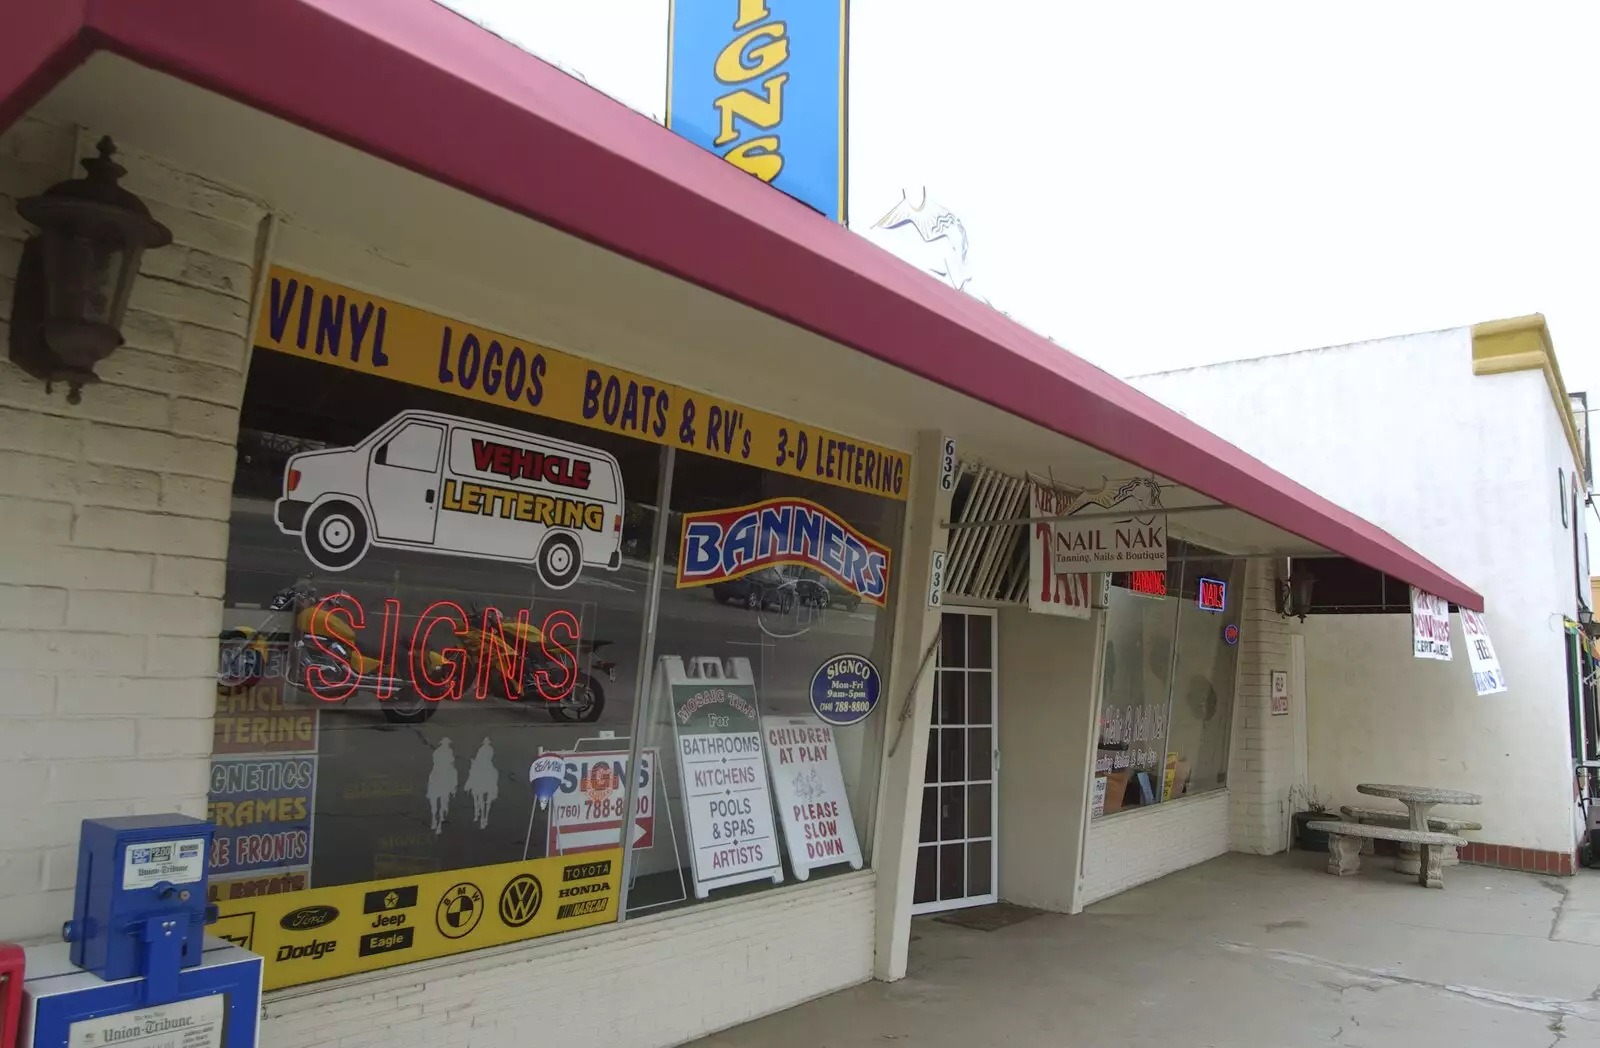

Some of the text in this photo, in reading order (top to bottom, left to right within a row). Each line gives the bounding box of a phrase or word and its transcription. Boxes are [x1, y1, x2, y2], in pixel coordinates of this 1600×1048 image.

[270, 278, 904, 494] VINYL LOGOS BOATS & RV's 3-D LETTERING
[471, 438, 591, 489] VEHICLE
[942, 439, 955, 490] 636
[442, 479, 604, 532] LETTERING
[1056, 527, 1163, 552] NAIL NAK
[684, 505, 886, 598] BANNERS
[1056, 550, 1165, 563] Tanning, Nails & Boutique
[931, 554, 943, 605] 636
[1202, 582, 1224, 608] NAILS
[305, 593, 581, 701] SIGNS
[827, 660, 871, 680] SIGNCO
[827, 690, 866, 699] 9am-5pm
[831, 680, 864, 689] Mon-Fri
[677, 687, 757, 724] MOSAIC TILE
[216, 716, 312, 745] TERING
[708, 713, 730, 727] For
[683, 735, 760, 756] BATHROOMS
[769, 727, 831, 746] CHILDREN
[780, 745, 829, 765] AT PLAY
[210, 761, 313, 794] GNETICS
[695, 766, 755, 788] KITCHENS
[557, 804, 580, 819] (760)
[709, 798, 752, 818] POOLS
[793, 801, 839, 822] PLEASE
[712, 818, 755, 840] & SPAS
[804, 820, 837, 840] SLOW
[235, 830, 308, 866] FRONTS
[713, 845, 763, 869] ARTISTS
[807, 838, 844, 859] DOWN
[565, 864, 610, 880] TOYOTA
[558, 882, 611, 898] HONDA
[571, 897, 609, 916] NASCAR
[291, 908, 329, 927] Ford
[371, 913, 406, 929] Jeep
[276, 939, 336, 962] Dodge
[369, 932, 404, 949] Eagle
